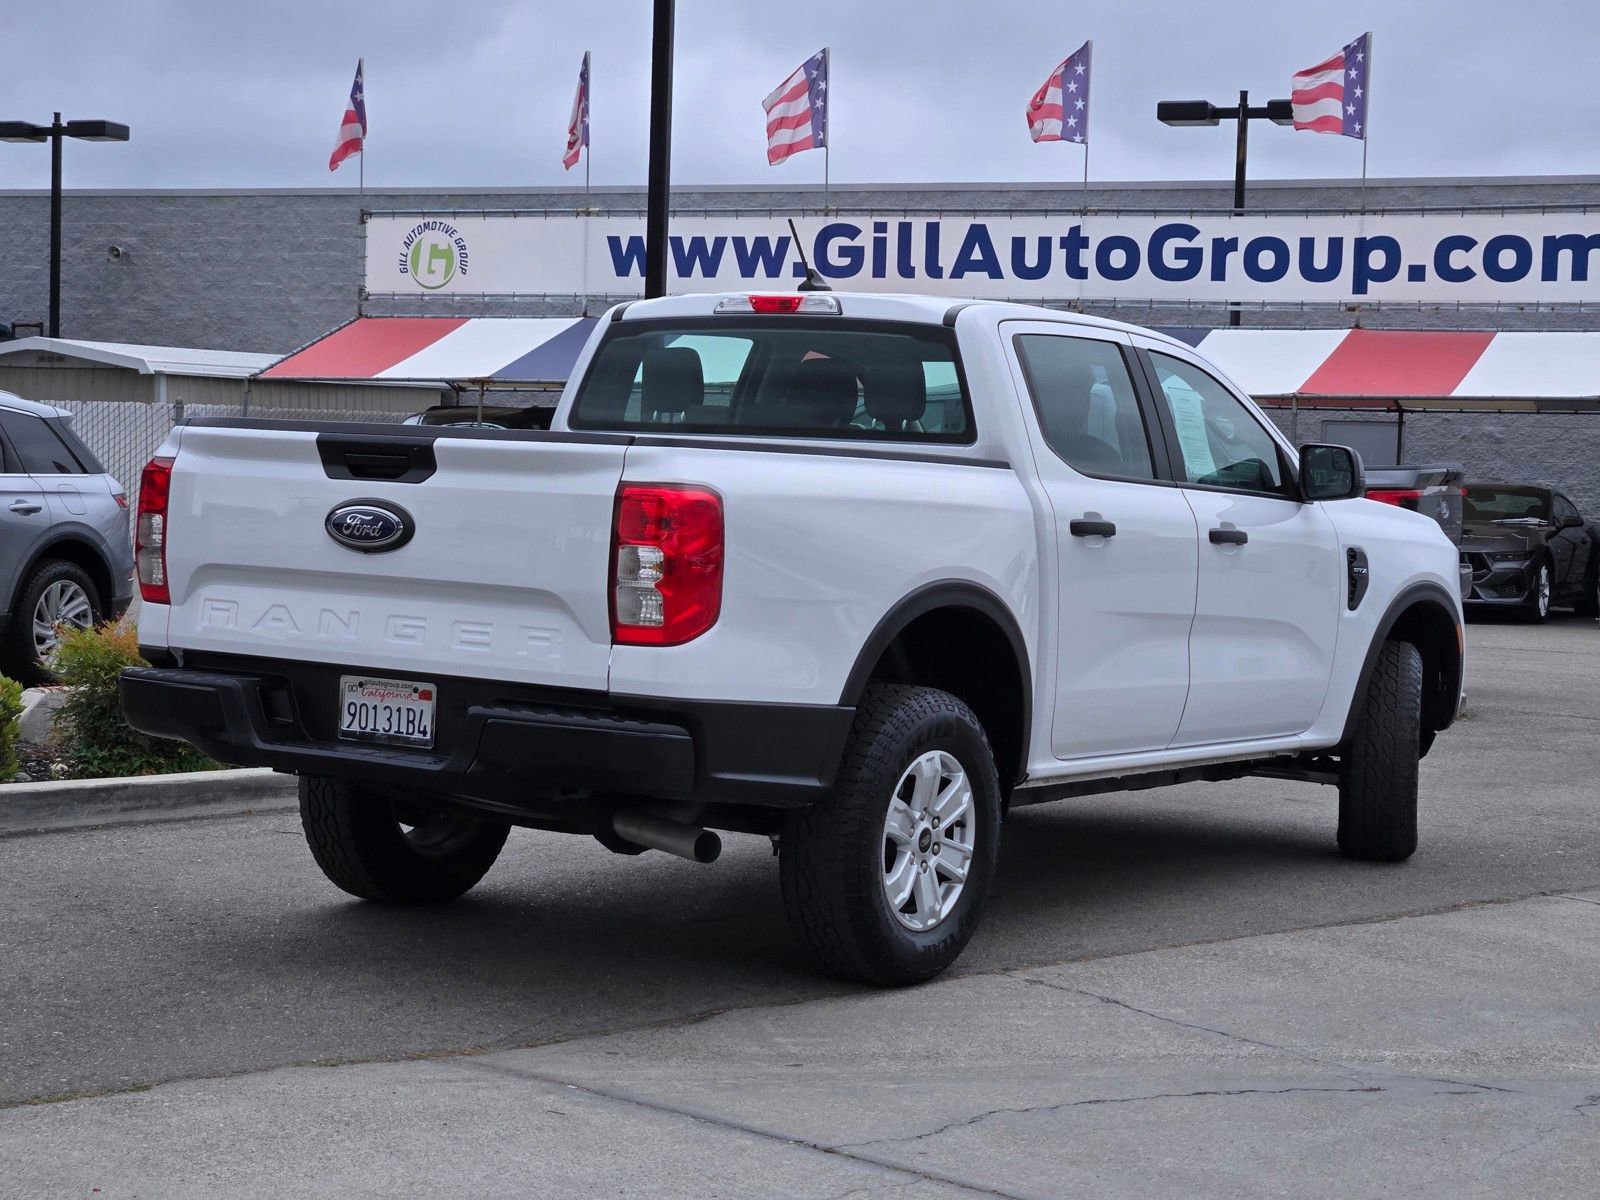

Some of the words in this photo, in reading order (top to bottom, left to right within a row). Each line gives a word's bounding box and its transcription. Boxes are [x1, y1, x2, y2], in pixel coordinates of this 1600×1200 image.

[403, 221, 458, 251] AUTOMOTIVE
[399, 252, 409, 274] GILL
[454, 237, 469, 276] GROUP
[607, 221, 1600, 295] www.GillAutoGroup.com
[341, 513, 382, 538] Ford
[199, 598, 564, 658] RANGER
[361, 687, 412, 703] California
[346, 701, 428, 737] 90131B4
